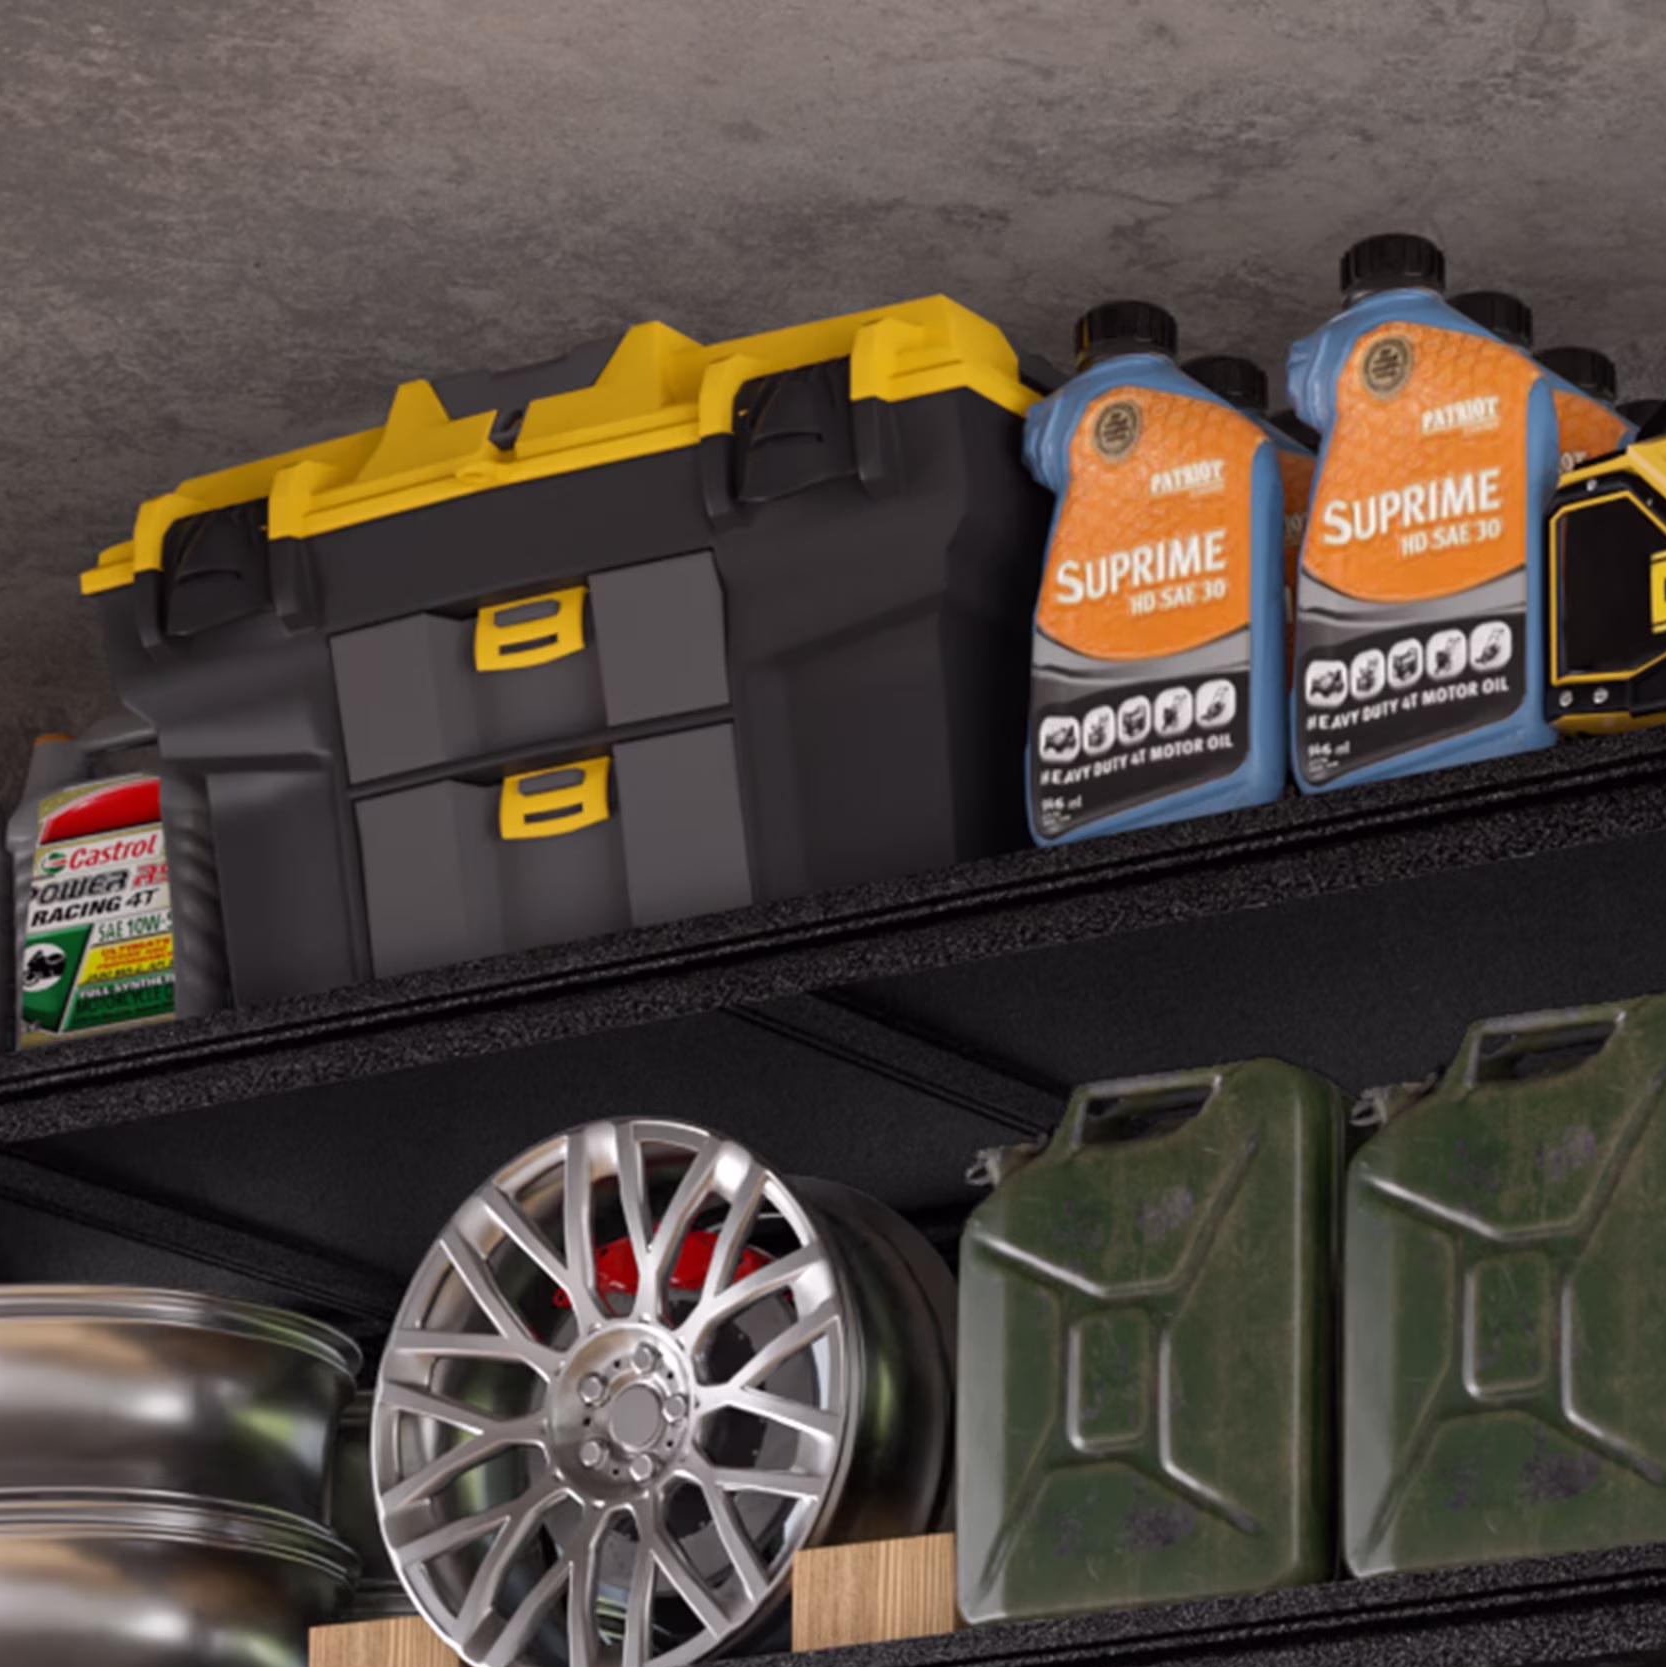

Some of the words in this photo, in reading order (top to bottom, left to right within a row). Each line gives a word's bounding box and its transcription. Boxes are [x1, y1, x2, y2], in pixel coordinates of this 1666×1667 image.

[1420, 396, 1500, 435] PATRIOT
[1150, 460, 1224, 497] PATRIOT
[1322, 467, 1502, 545] SUPRIME
[1401, 531, 1428, 558] HD
[1432, 524, 1470, 551] SAE
[1476, 518, 1502, 542] 30
[1056, 528, 1227, 604] SUPRIME
[1131, 591, 1156, 616] HD
[1161, 582, 1197, 609] SAE
[1202, 578, 1226, 600] 30
[1362, 699, 1399, 722] DUTY
[1422, 682, 1479, 706] MOTOR
[1482, 677, 1510, 695] OIL
[1093, 754, 1129, 777] DUTY
[1150, 739, 1205, 761] MOTOR
[1207, 733, 1234, 749] OIL
[69, 834, 157, 871] Castrol
[32, 896, 121, 927] RACING
[126, 888, 160, 907] 4T
[98, 919, 123, 942] SAE
